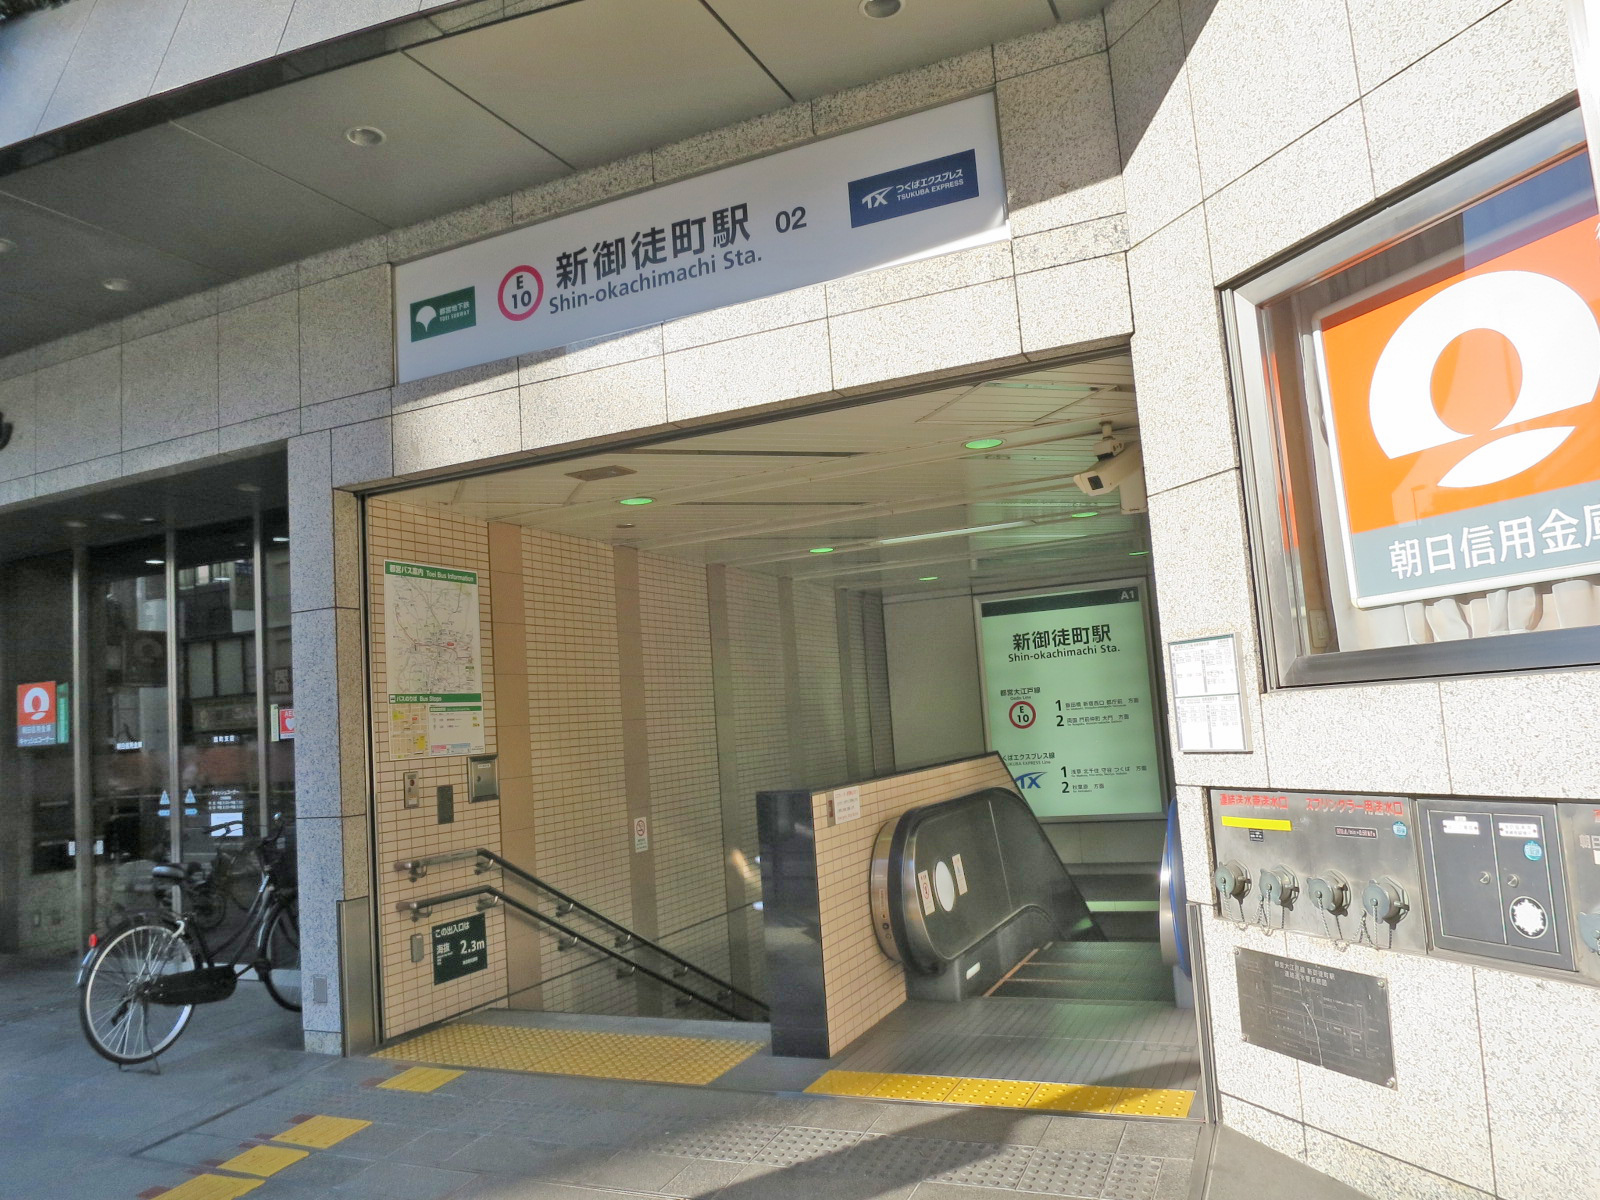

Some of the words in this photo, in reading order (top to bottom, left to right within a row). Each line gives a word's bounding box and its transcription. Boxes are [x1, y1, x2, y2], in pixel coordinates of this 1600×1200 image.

[896, 169, 964, 193] つくばエクスプレス
[862, 186, 894, 209] TX
[897, 187, 930, 201] TSUKUBA
[932, 179, 964, 193] EXPRESS
[556, 202, 751, 290] 新御徒町駅
[775, 206, 807, 233] 02
[516, 275, 524, 290] E
[549, 255, 716, 314] Shin-okachimachi
[723, 249, 763, 270] Sta.
[512, 290, 532, 309] 10
[437, 571, 447, 579] Bus
[1121, 590, 1135, 600] A1
[1012, 623, 1111, 652] 新御徒町駅
[1008, 645, 1097, 662] Shin-okachimachi
[1100, 645, 1120, 653] Sta.
[1000, 687, 1041, 696] 都営大江戸線
[1055, 700, 1061, 711] 1
[1017, 714, 1030, 722] 10
[1056, 715, 1064, 727] 2
[1061, 766, 1067, 777] 1
[1062, 781, 1070, 793] 2
[435, 921, 470, 938] この出入口は
[460, 939, 485, 954] 2.3m
